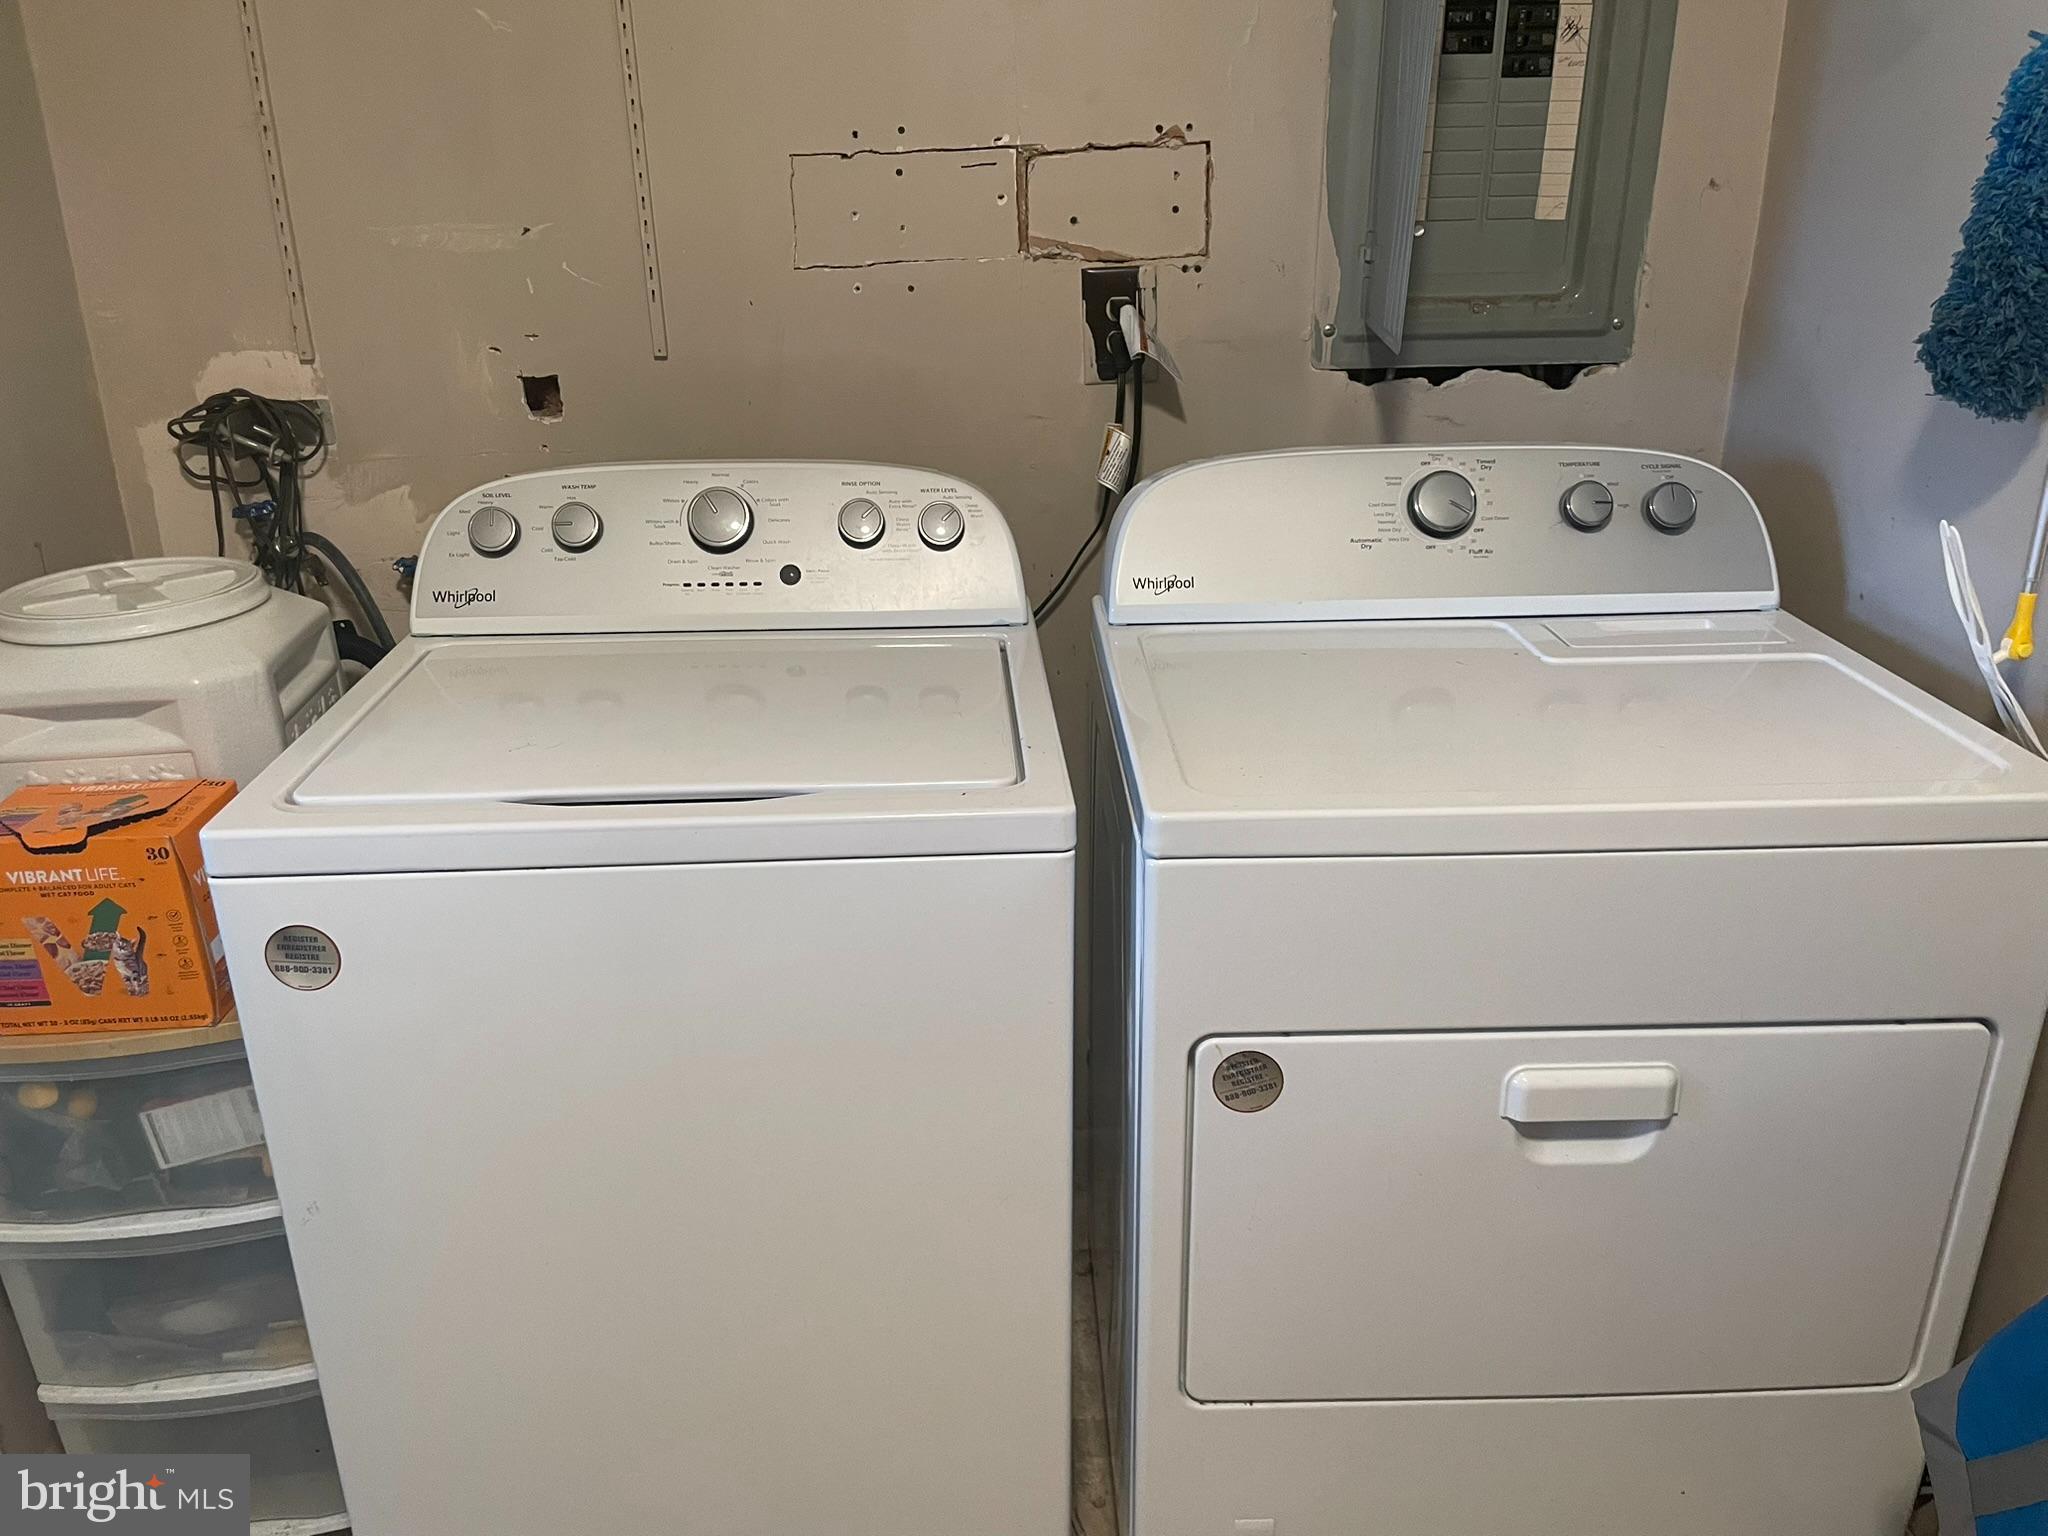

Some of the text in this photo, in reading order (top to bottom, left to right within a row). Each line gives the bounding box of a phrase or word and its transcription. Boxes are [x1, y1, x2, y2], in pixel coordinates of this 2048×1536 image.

[1132, 575, 1195, 596] Whirlpool
[432, 588, 496, 608] Whirlpool
[70, 783, 142, 793] VIBRANT
[145, 846, 170, 861] 30
[5, 867, 120, 885] VIBRANT LIFE
[283, 935, 319, 943] REGISTER
